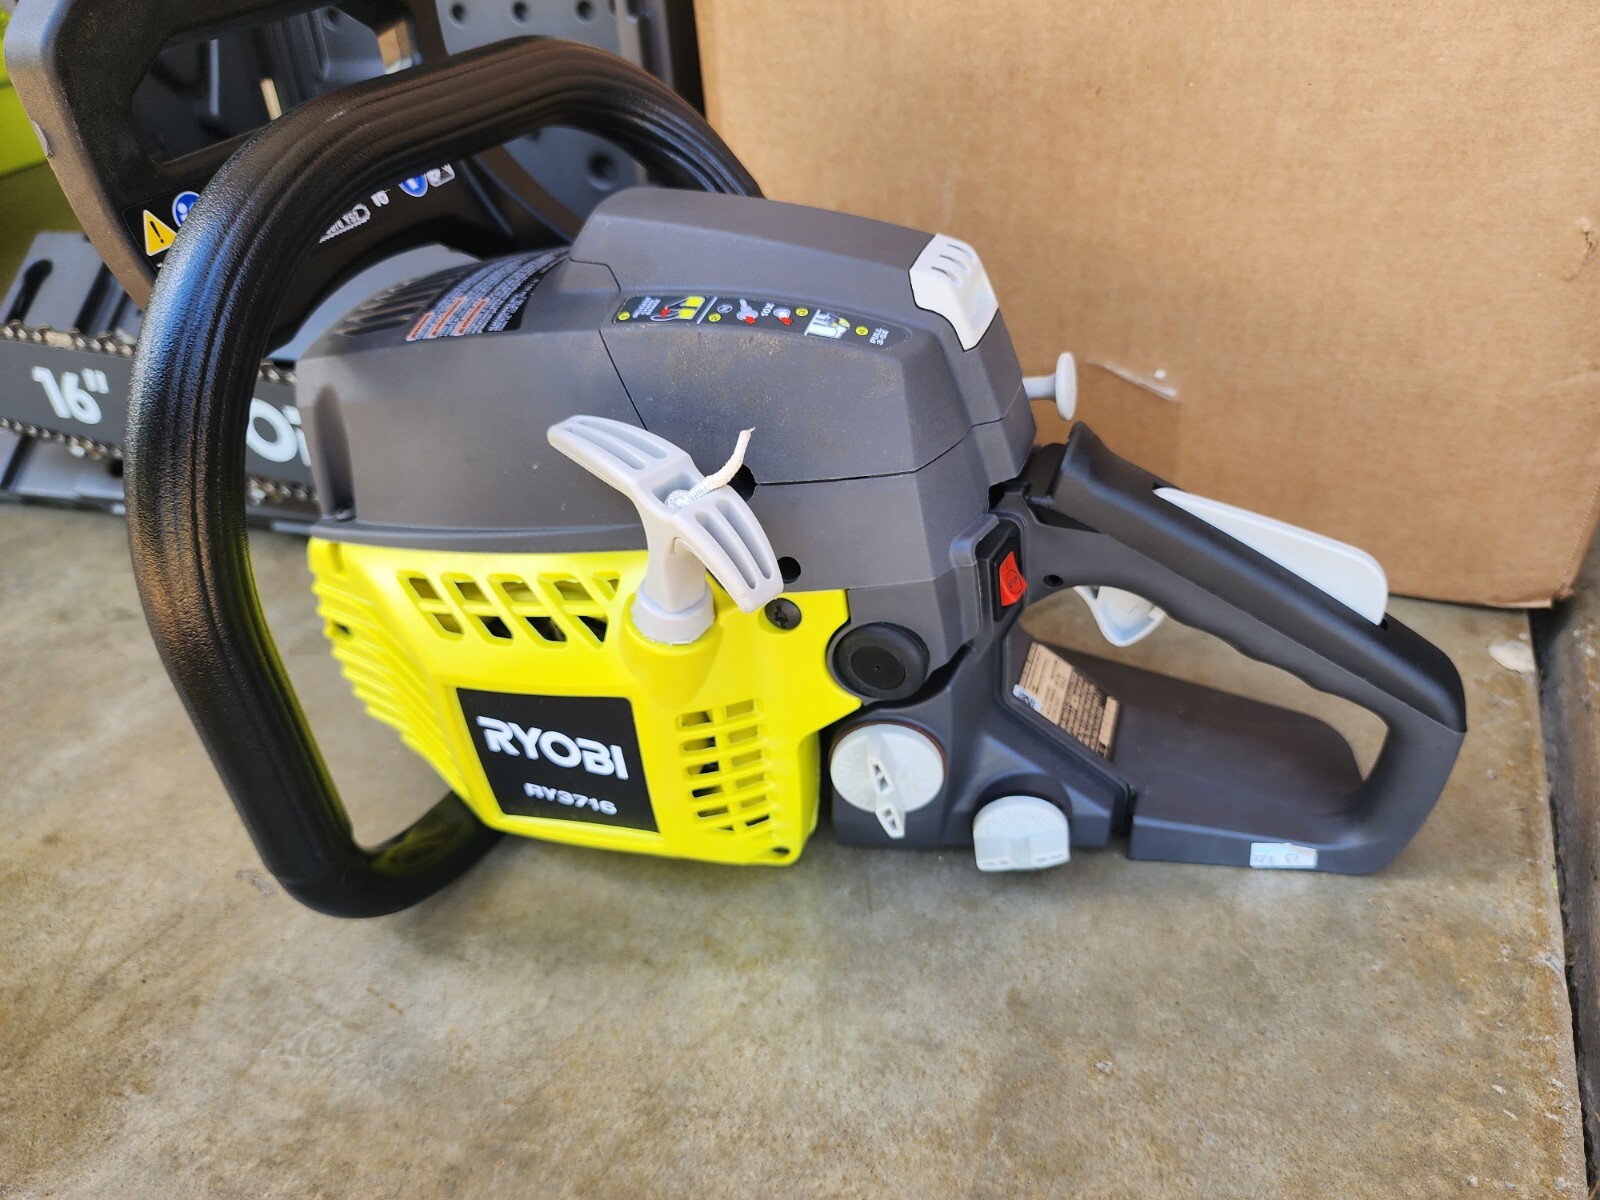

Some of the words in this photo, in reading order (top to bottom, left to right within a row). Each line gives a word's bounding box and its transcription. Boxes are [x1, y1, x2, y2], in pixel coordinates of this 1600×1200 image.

[869, 327, 883, 344] PULL
[31, 366, 110, 424] 16"
[476, 715, 629, 780] RYOBI
[523, 782, 618, 815] RY3716
